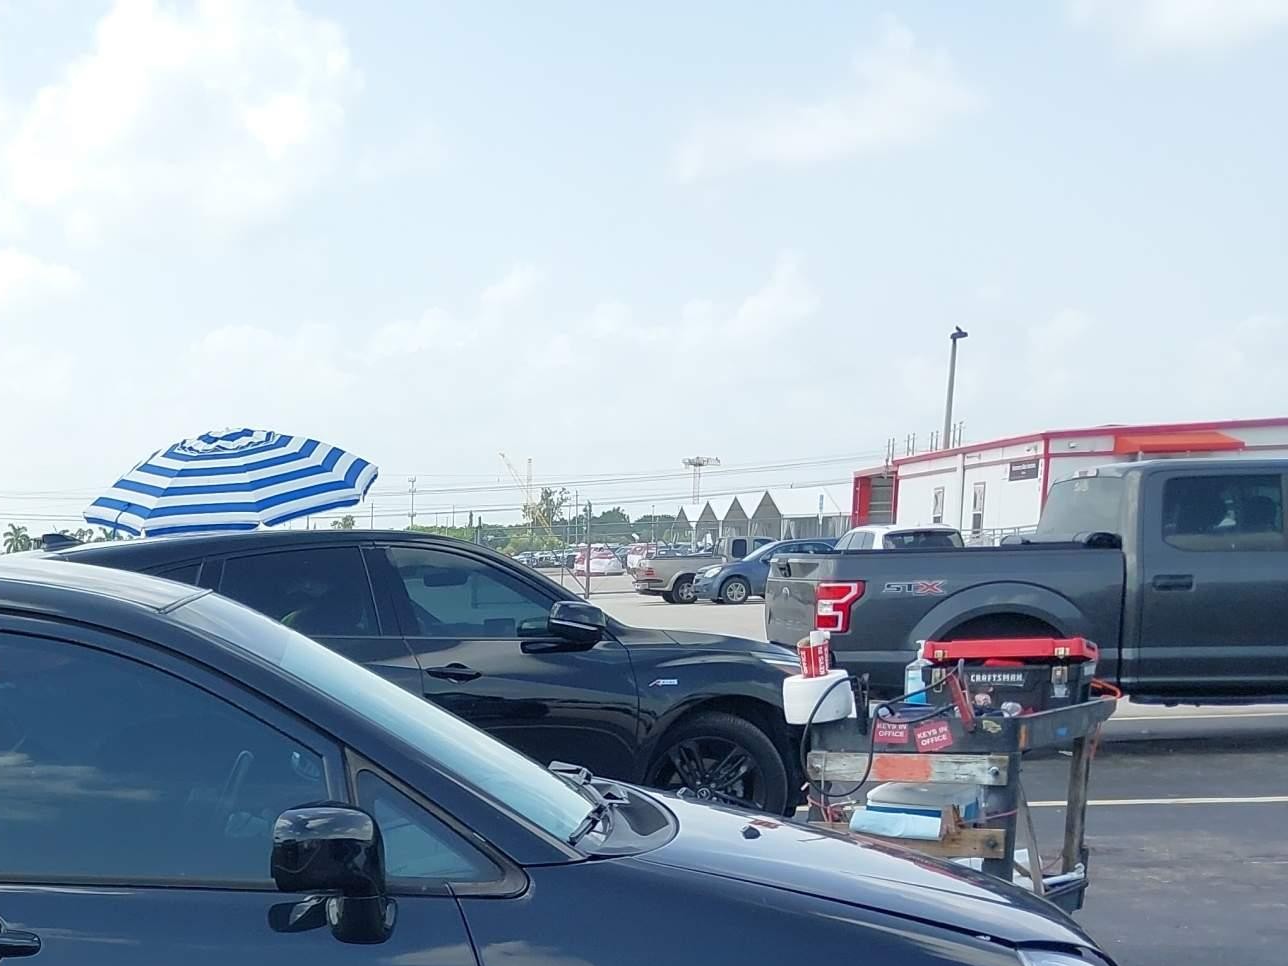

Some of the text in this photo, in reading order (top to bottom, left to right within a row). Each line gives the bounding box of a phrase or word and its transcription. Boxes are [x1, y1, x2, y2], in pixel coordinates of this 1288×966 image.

[882, 581, 944, 595] STX
[970, 673, 1022, 682] CRAFTSMAN
[917, 725, 948, 739] KEYS IN
[920, 734, 948, 746] OFFICE
